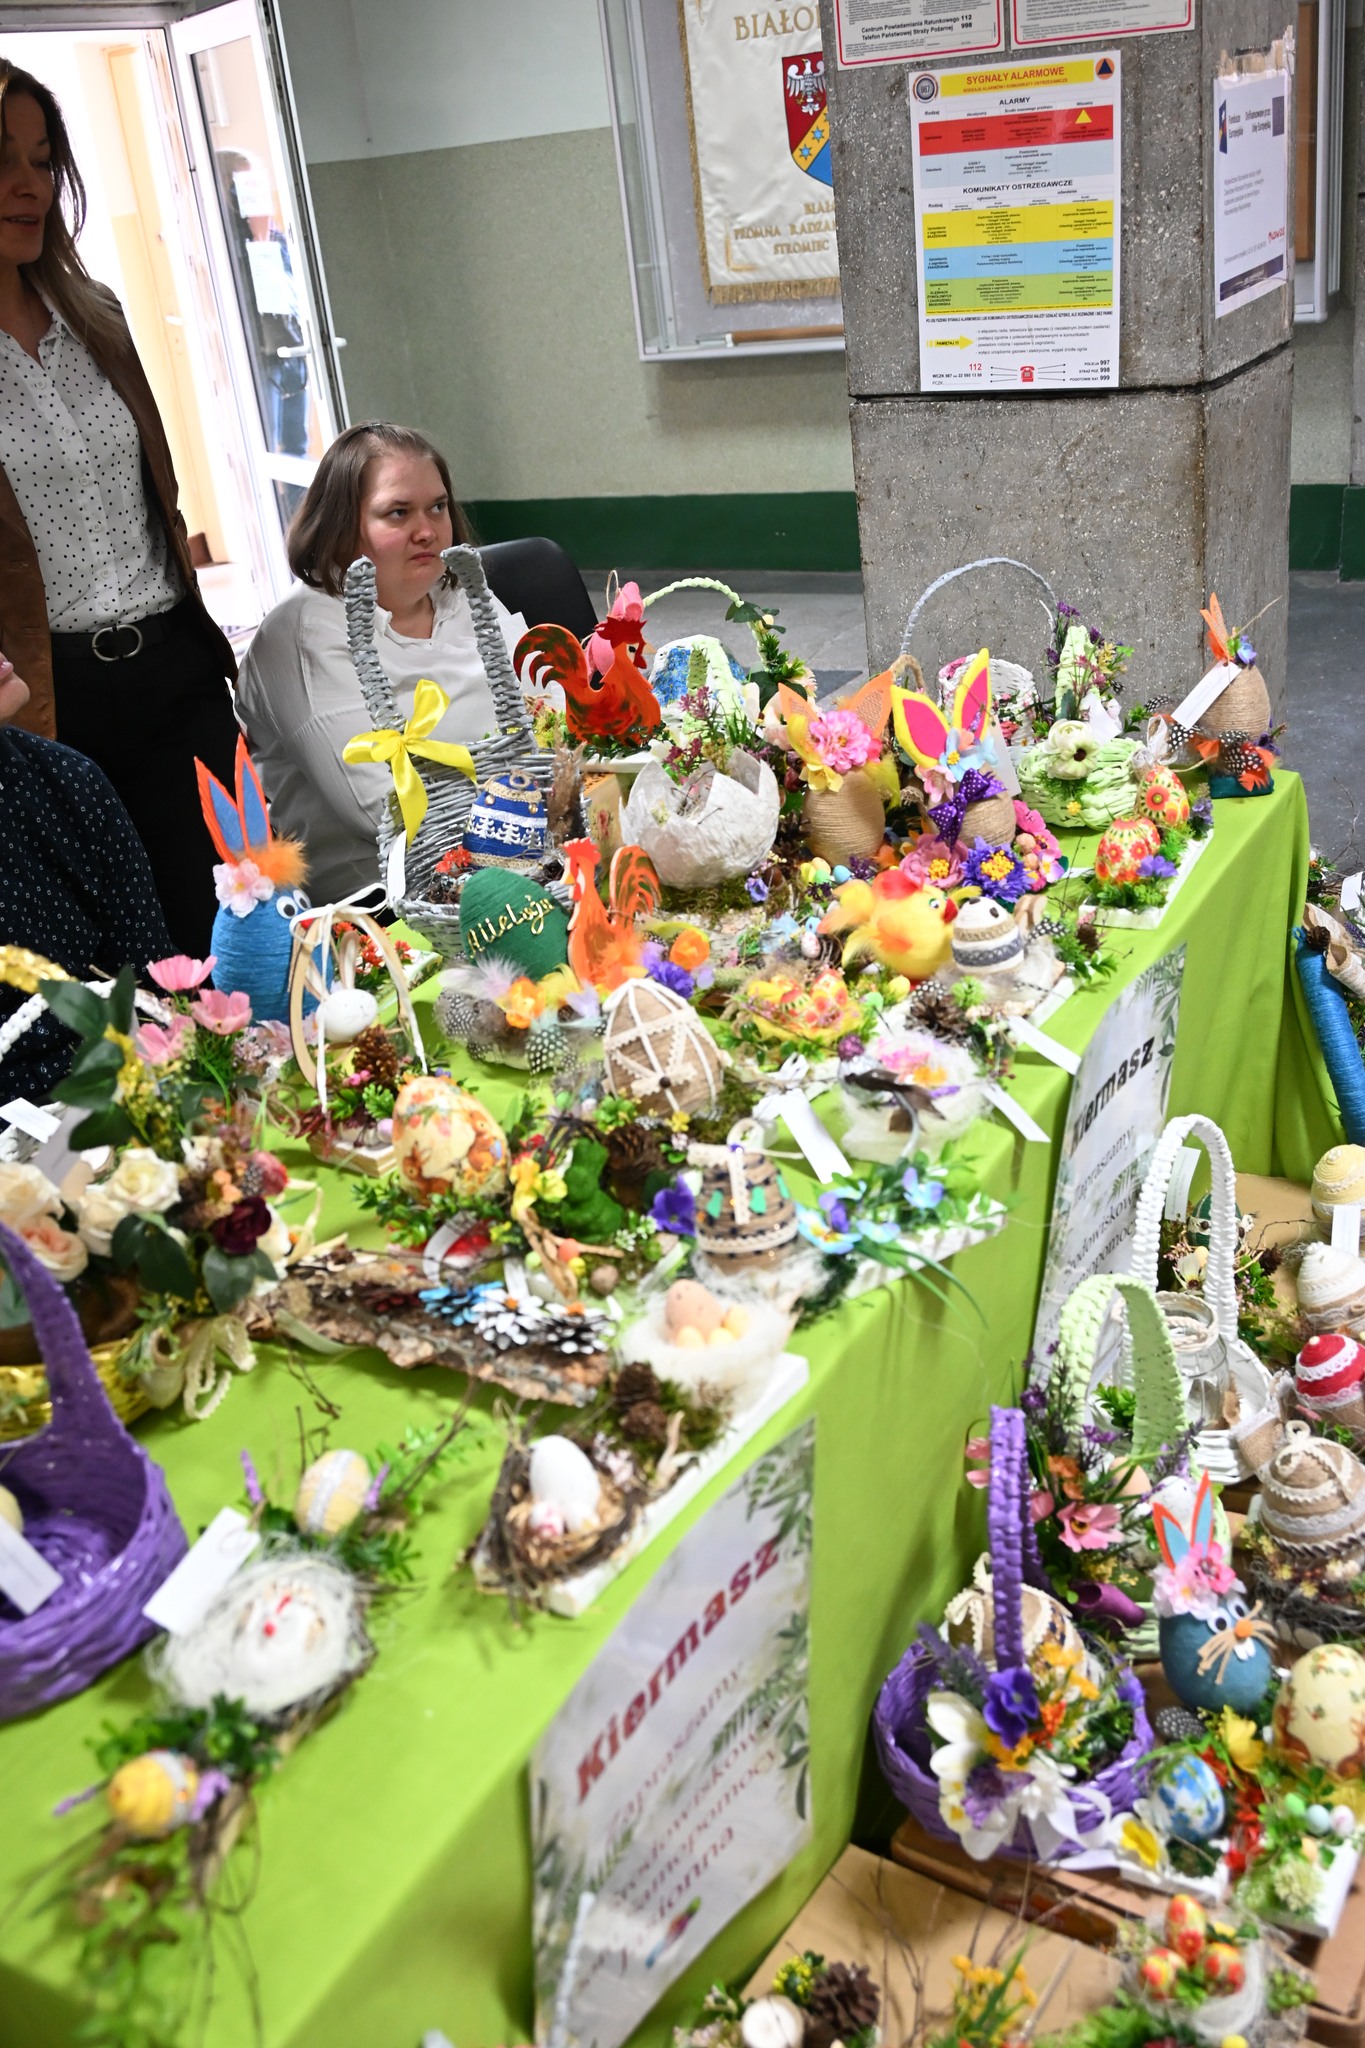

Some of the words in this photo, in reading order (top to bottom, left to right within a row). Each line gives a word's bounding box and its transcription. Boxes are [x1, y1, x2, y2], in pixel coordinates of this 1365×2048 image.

[733, 4, 821, 41] BIAŁO
[861, 24, 884, 34] Centrum
[884, 20, 923, 31] Powiadamiania
[924, 16, 960, 27] Ratunkowego
[961, 14, 972, 22] 112
[862, 32, 881, 41] Telefon
[881, 30, 912, 40] Państwowej
[913, 26, 930, 36] Straży
[930, 25, 954, 34] Pożarnej
[960, 22, 973, 30] 998
[966, 72, 1009, 85] SYGNAŁY
[1010, 66, 1065, 82] ALARMOWE
[999, 96, 1030, 106] ALARMY
[962, 184, 1010, 194] KOMUNIKATY
[1012, 180, 1073, 192] OSTRZEGAWCZE
[774, 240, 830, 256] STROMIEC
[1069, 1036, 1155, 1159] Kiermasz
[577, 1536, 780, 1805] Kiermasz
